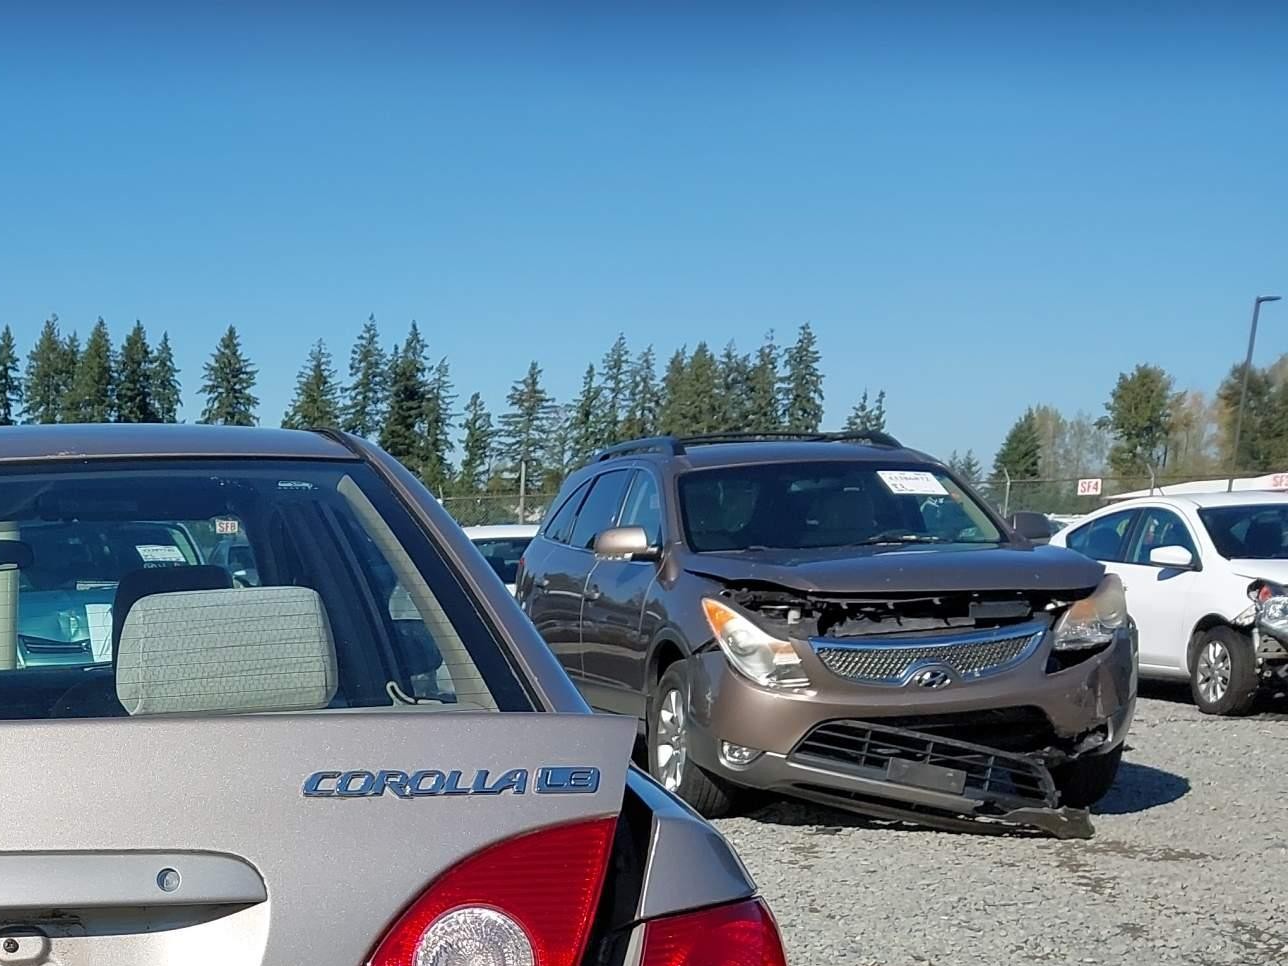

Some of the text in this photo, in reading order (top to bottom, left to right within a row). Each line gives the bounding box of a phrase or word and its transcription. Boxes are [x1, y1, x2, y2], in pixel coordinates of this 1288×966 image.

[1080, 480, 1098, 493] SF4
[302, 768, 596, 799] COROLLA LE
